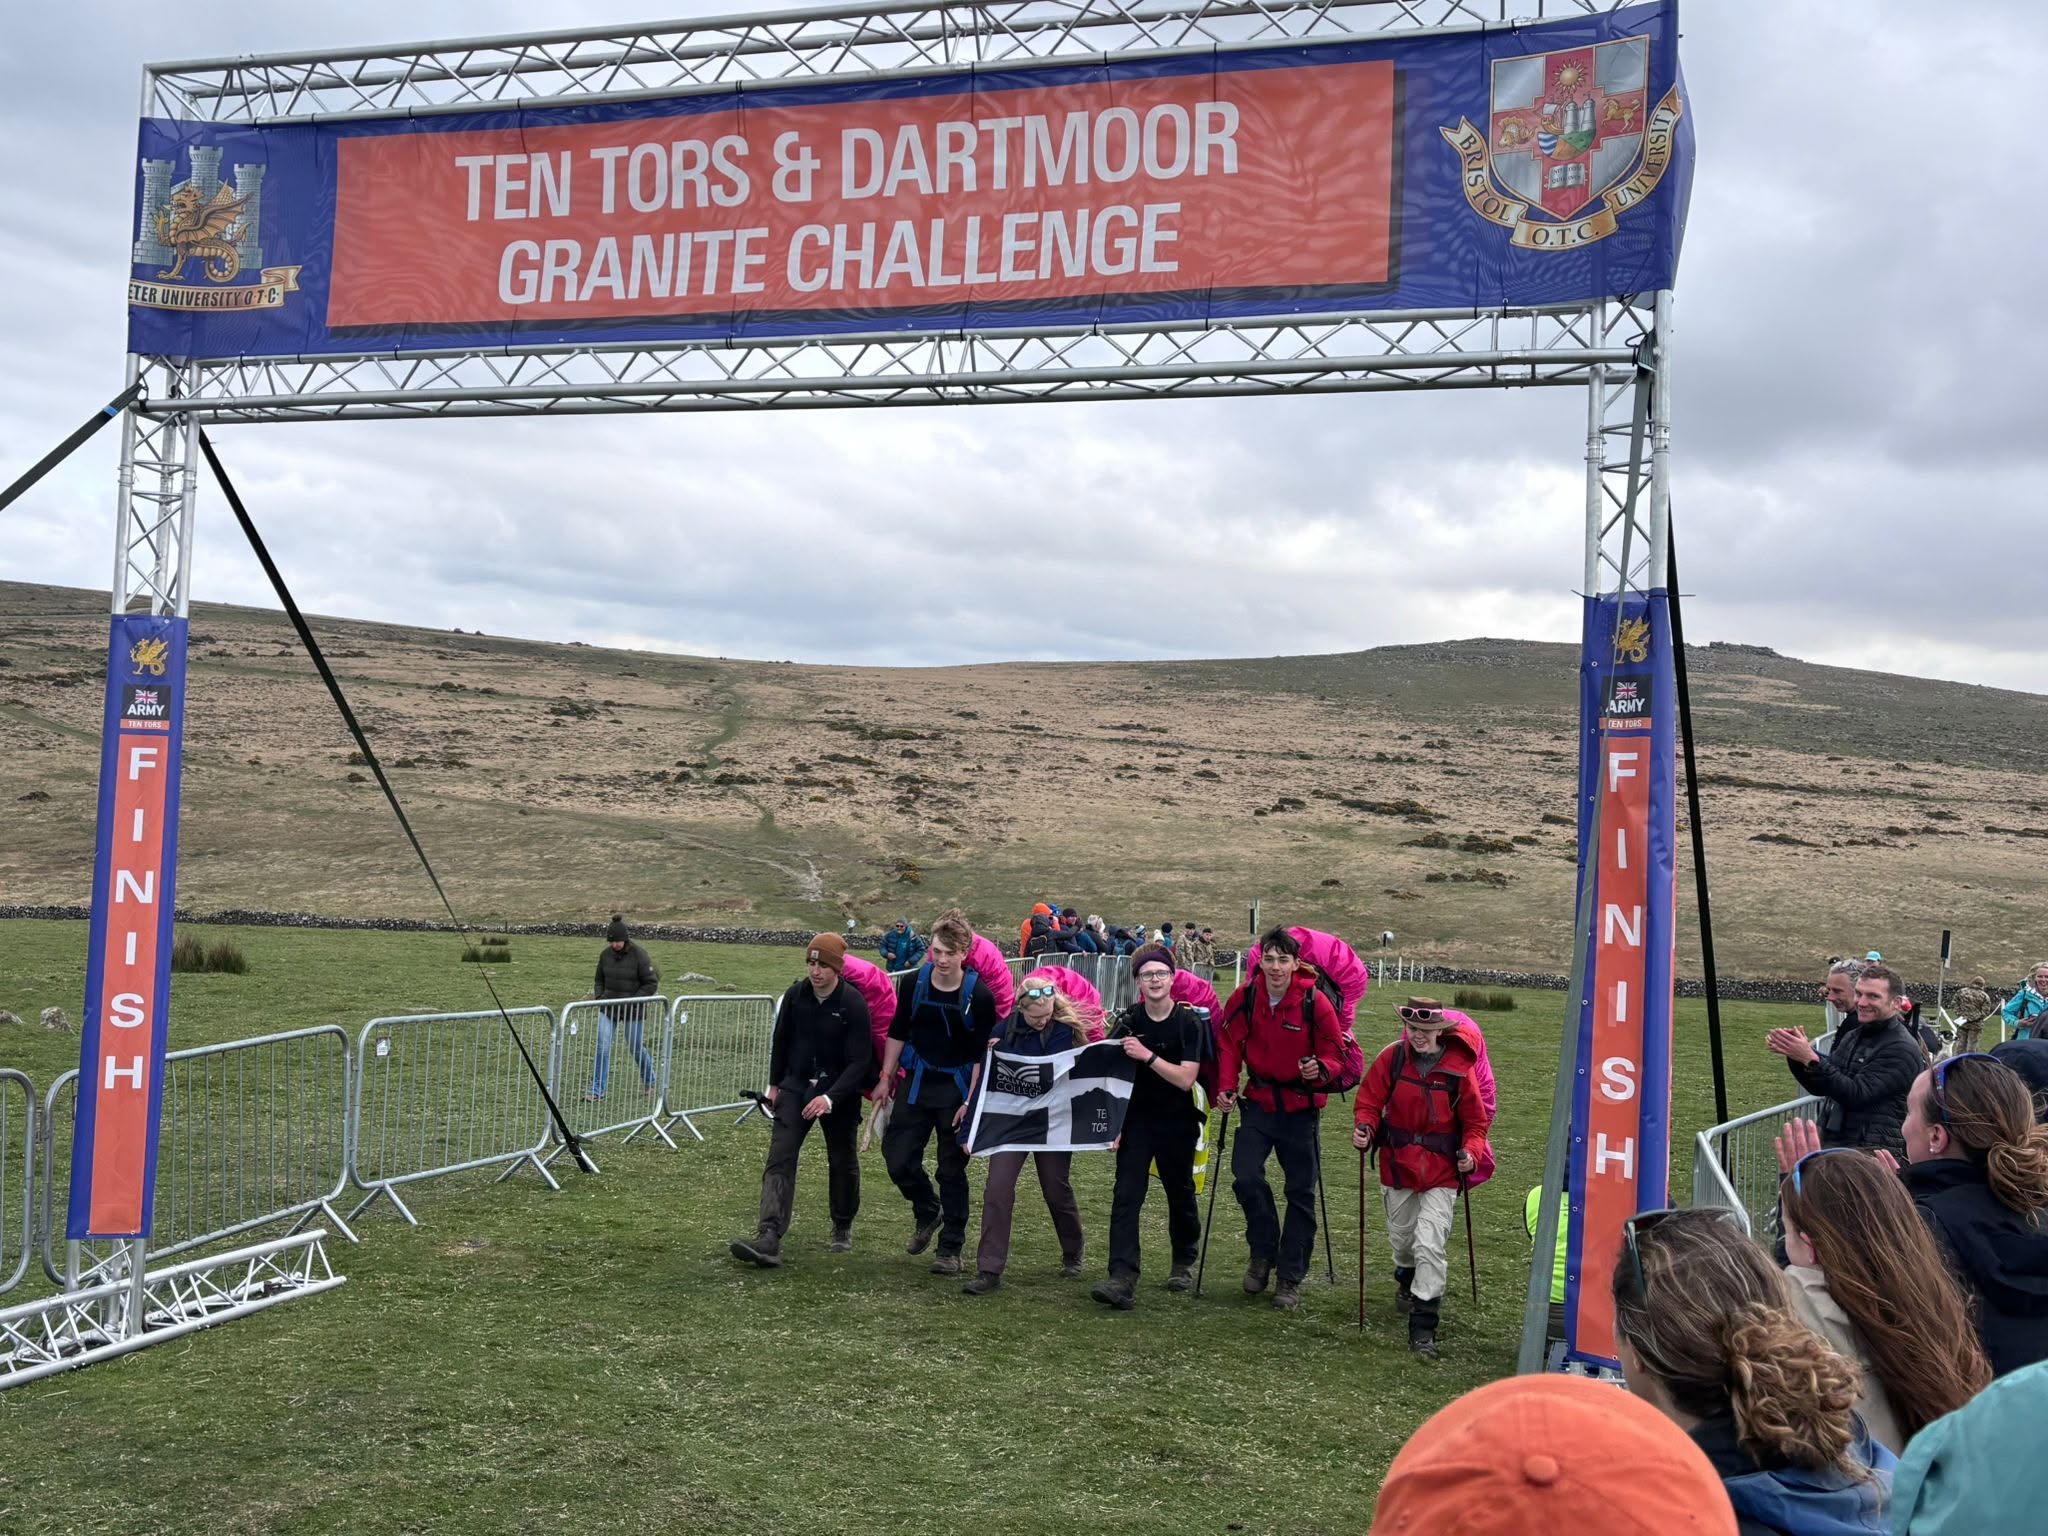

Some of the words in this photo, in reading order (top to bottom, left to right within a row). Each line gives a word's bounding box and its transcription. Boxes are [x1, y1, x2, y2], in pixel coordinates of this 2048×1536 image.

[455, 150, 571, 221] TEN
[590, 135, 750, 214] TORS
[772, 131, 821, 202] &
[841, 101, 1240, 199] DARTMOOR
[1458, 132, 1511, 222] BRISTOL
[1614, 102, 1678, 208] UNIVERSITY
[1532, 222, 1600, 245] O.T.C.
[499, 226, 769, 304] GRANITE
[786, 202, 1181, 292] CHALLENGE
[161, 287, 242, 307] UNIVERSITY
[127, 703, 165, 716] ARMY
[1605, 698, 1646, 713] ARMY
[128, 720, 142, 728] TEN
[1608, 719, 1623, 728] TEN
[1625, 719, 1642, 728] TORS
[104, 747, 158, 1089] FINISH
[1595, 752, 1642, 1179] FINISH
